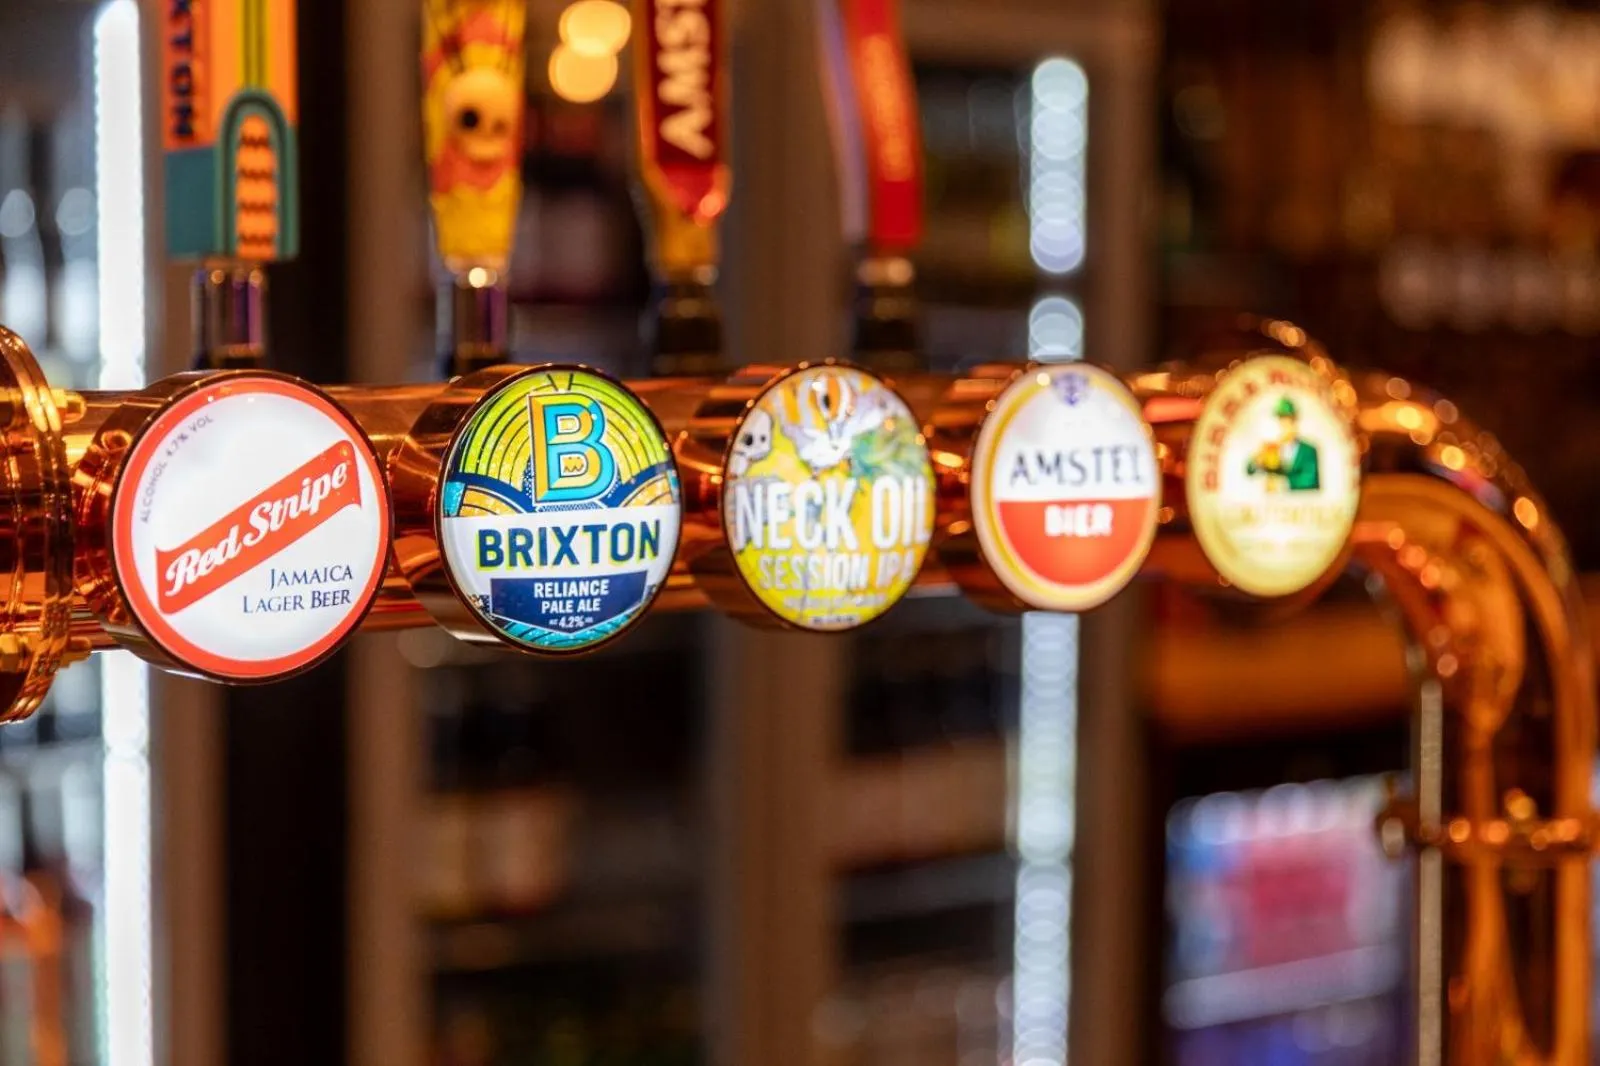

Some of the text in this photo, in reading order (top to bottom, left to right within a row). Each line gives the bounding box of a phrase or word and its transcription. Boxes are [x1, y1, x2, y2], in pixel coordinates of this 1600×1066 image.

[655, 0, 713, 159] AMS
[141, 460, 168, 524] ALCOHOL
[188, 414, 214, 432] VOL
[1009, 444, 1143, 486] AMSTEL
[164, 460, 347, 598] Red Stripe
[734, 475, 932, 553] NECK OIL
[1044, 504, 1113, 537] BIER
[476, 519, 661, 571] BRIXTON
[270, 565, 353, 590] JAMAICA
[533, 579, 610, 598] RELIANCE
[759, 551, 869, 591] SESSION
[243, 589, 352, 614] LAGER BEER
[541, 598, 601, 615] PALE ALE
[559, 615, 585, 628] 4.2%
